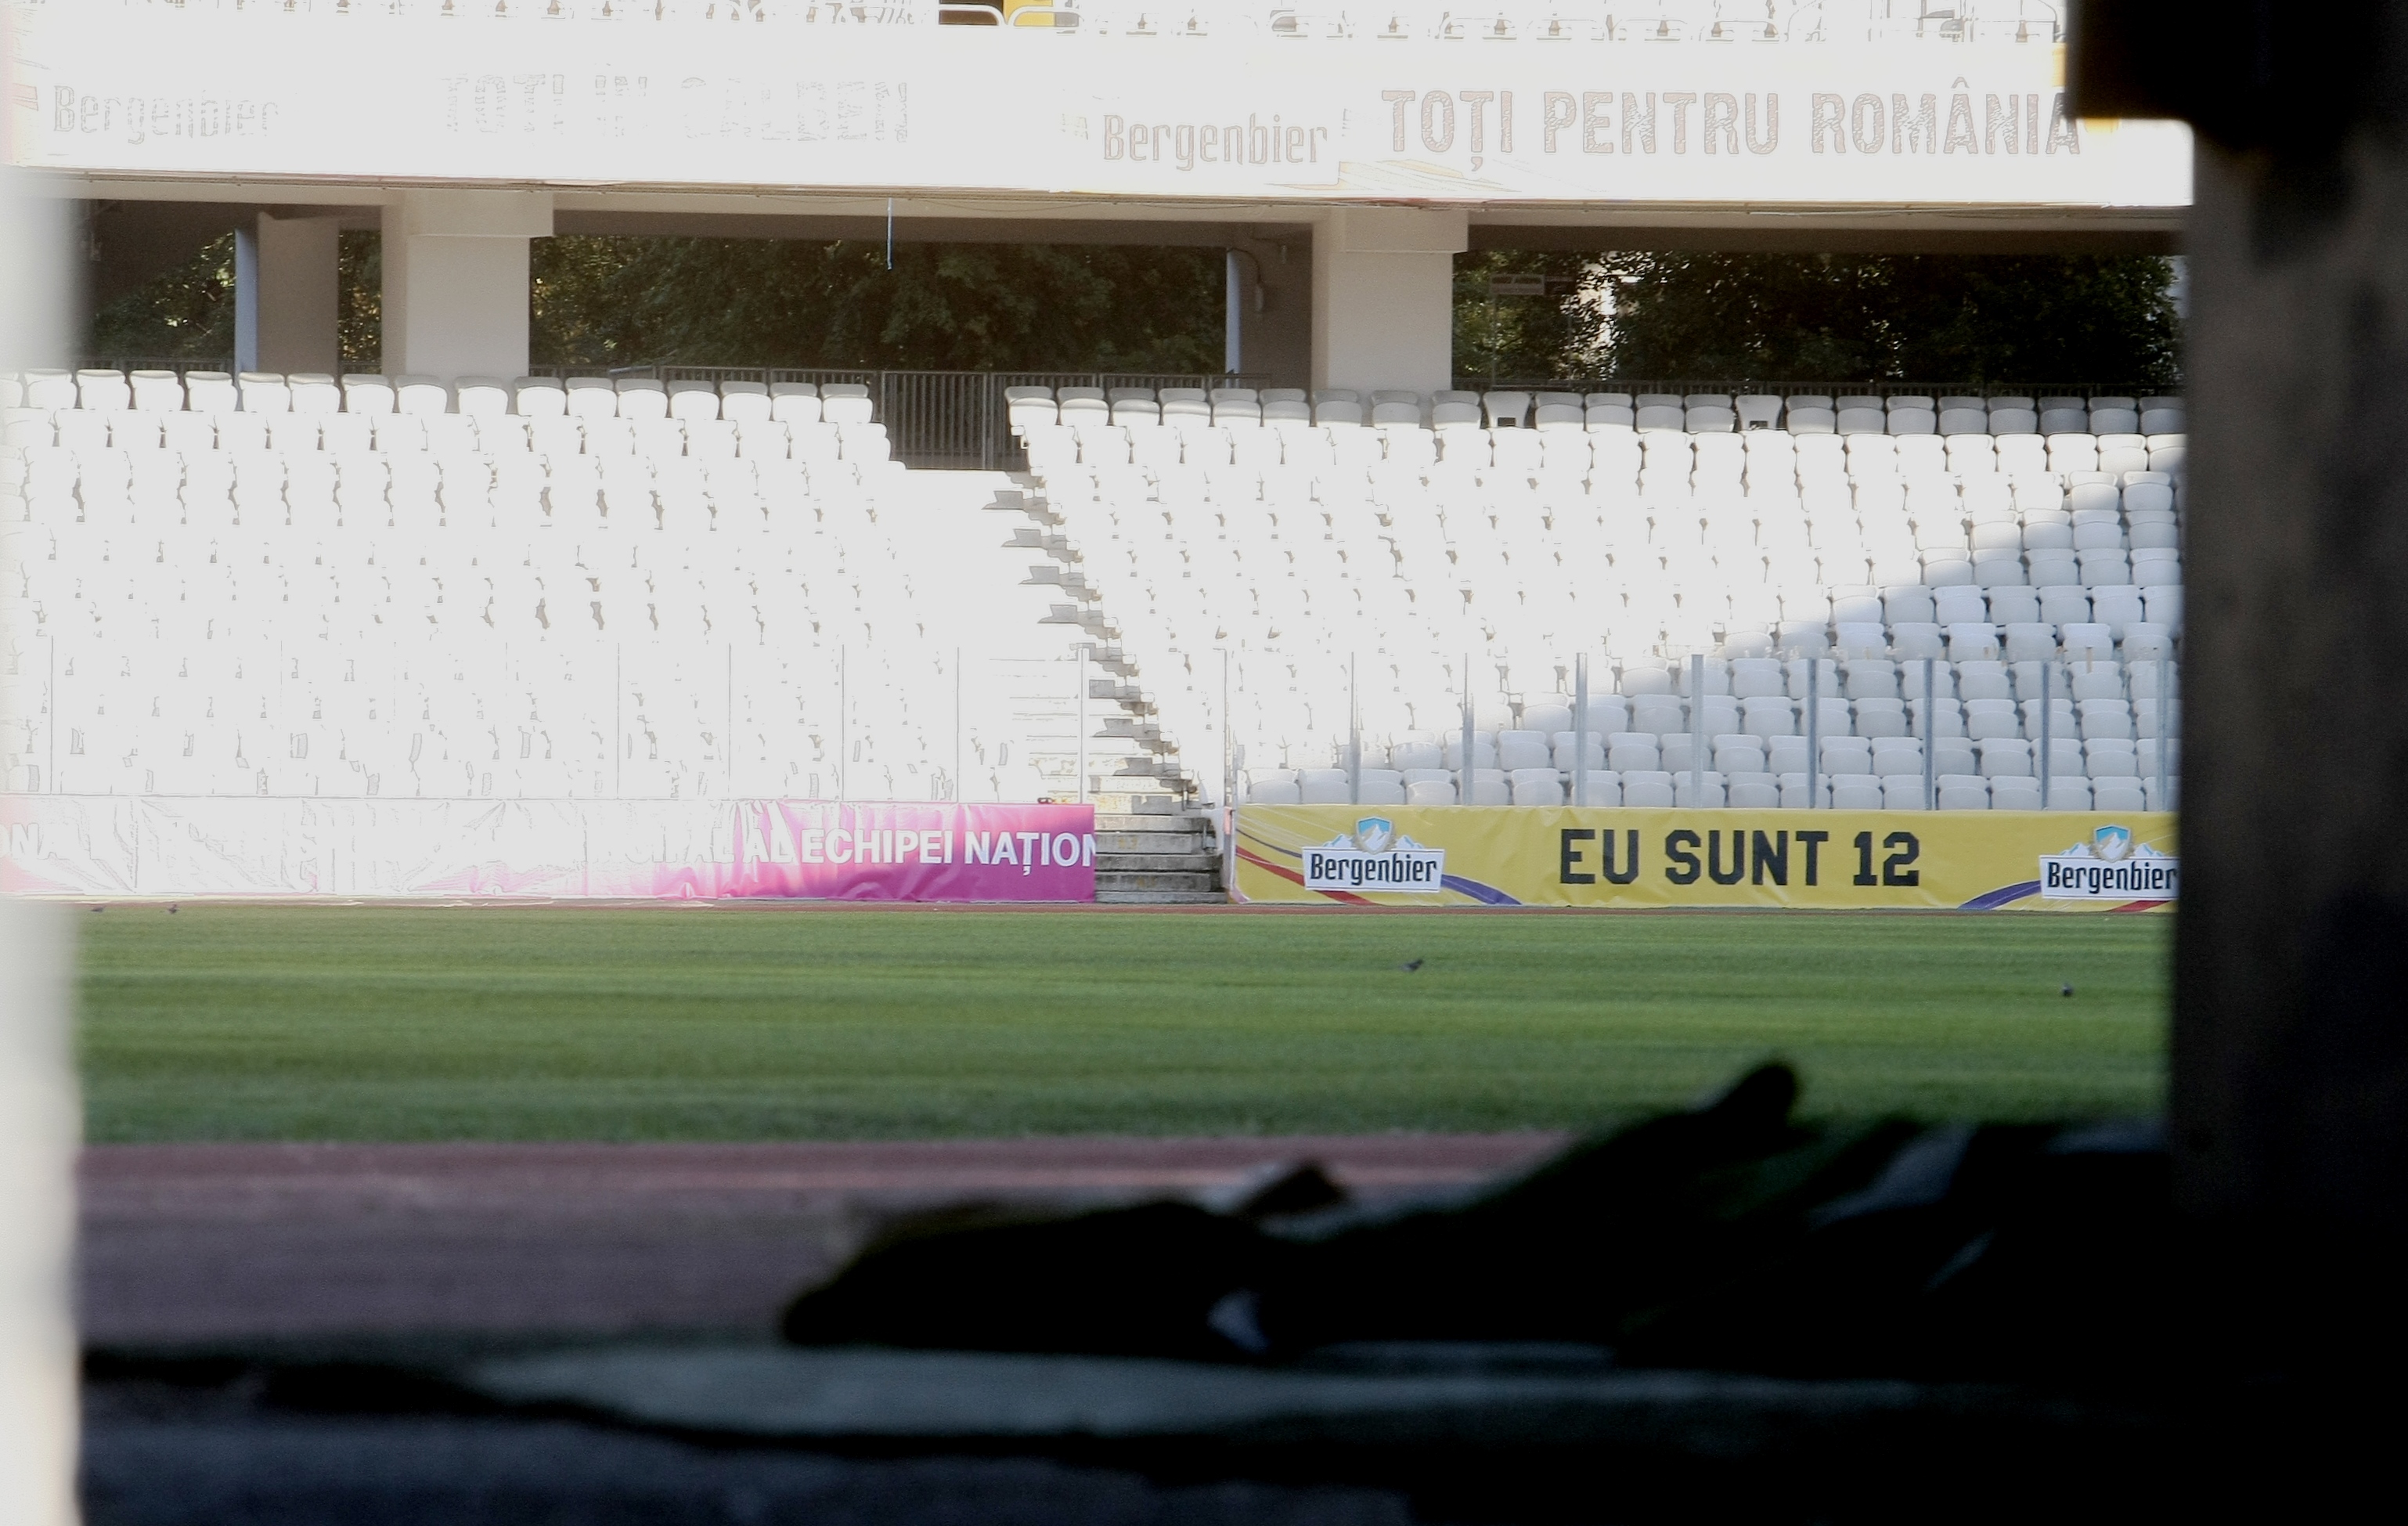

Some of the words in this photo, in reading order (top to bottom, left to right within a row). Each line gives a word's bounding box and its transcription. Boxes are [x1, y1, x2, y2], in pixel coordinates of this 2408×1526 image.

[53, 85, 279, 145] Bergenbier
[1102, 112, 1328, 171] Bergenbier
[1382, 90, 1512, 173] TOȚI
[1544, 91, 1779, 155] PENTRU
[1811, 76, 2081, 155] ROMÂNIA
[801, 828, 953, 864] ECHIPEI
[1310, 853, 1437, 886] Bergenbier
[1560, 828, 1639, 885] EU
[1664, 829, 1829, 886] SUNT
[1853, 831, 1920, 886] 12
[2047, 860, 2177, 894] Bergenbier
